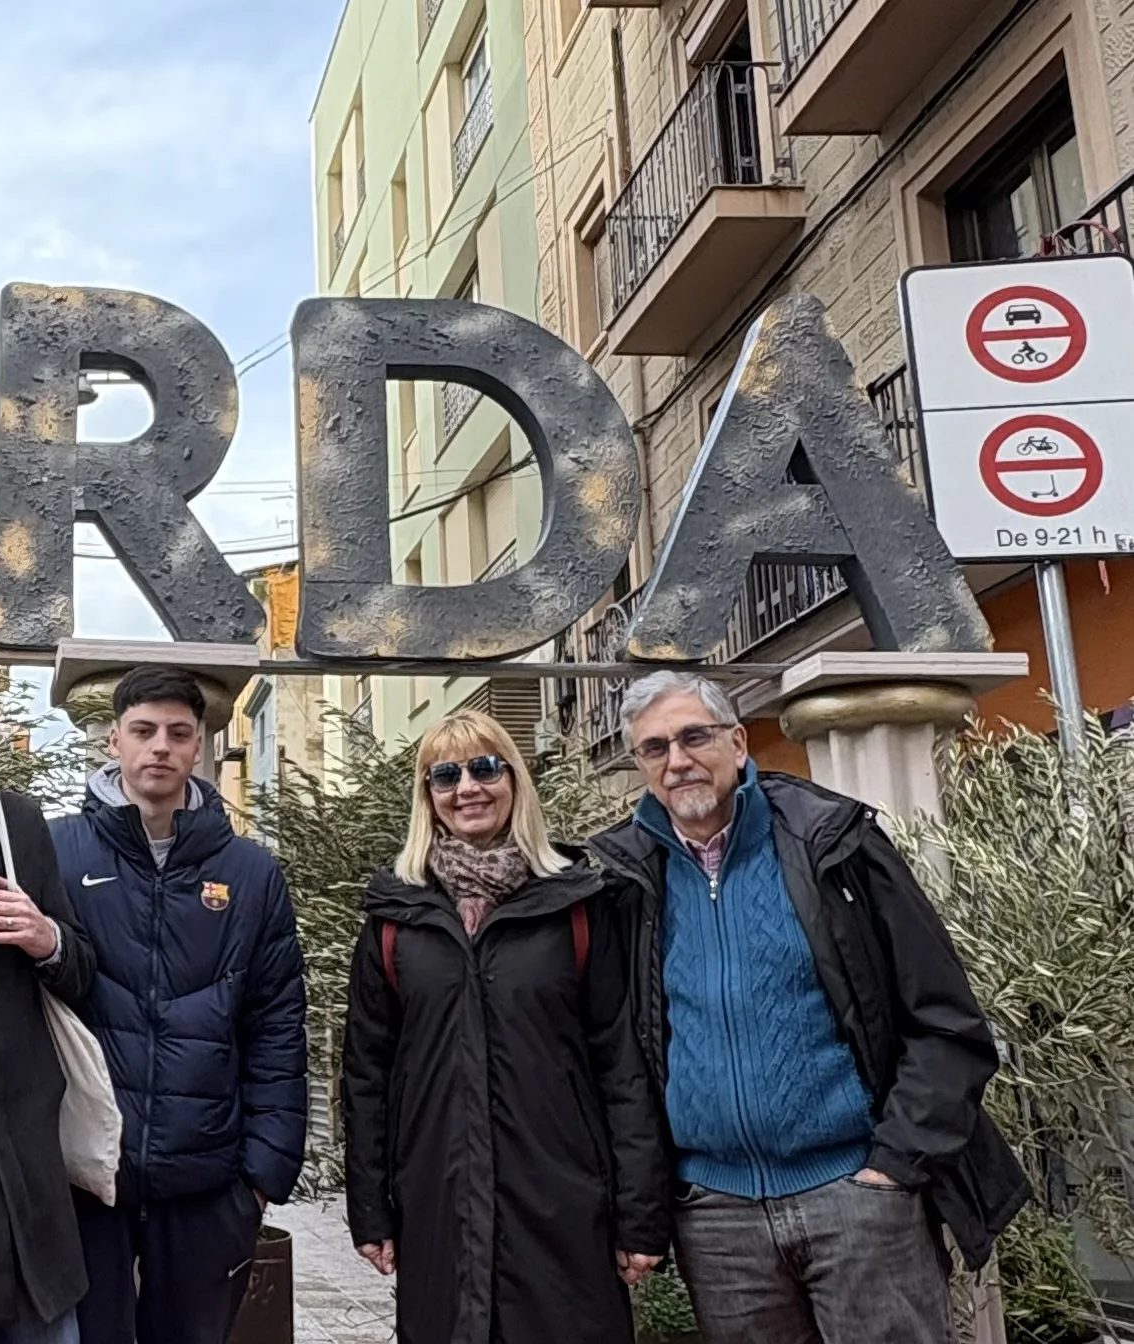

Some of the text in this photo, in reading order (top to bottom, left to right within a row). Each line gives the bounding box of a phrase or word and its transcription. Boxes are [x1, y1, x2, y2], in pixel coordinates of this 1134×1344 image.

[996, 525, 1107, 547] De 9-21 h
